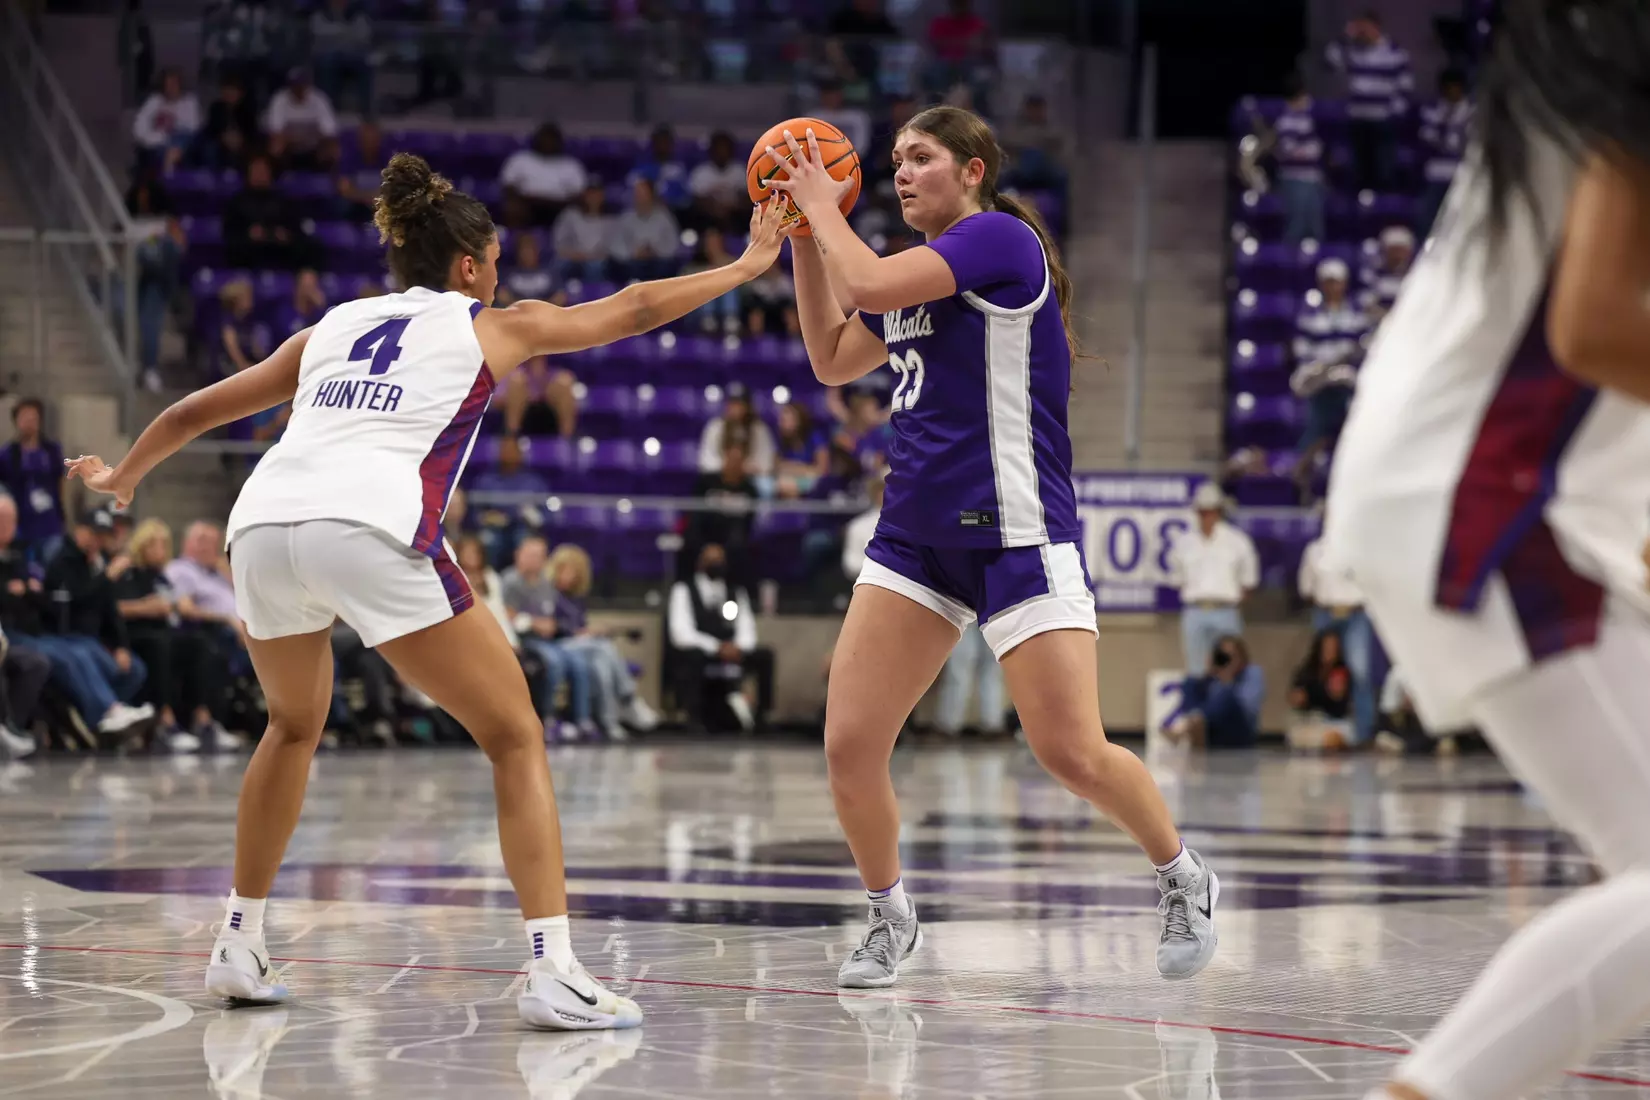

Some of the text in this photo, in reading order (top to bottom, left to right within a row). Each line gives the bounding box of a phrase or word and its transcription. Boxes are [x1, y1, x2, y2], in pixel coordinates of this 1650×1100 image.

[347, 318, 412, 375] 4
[311, 380, 403, 412] HUNTER
[888, 348, 925, 412] 23
